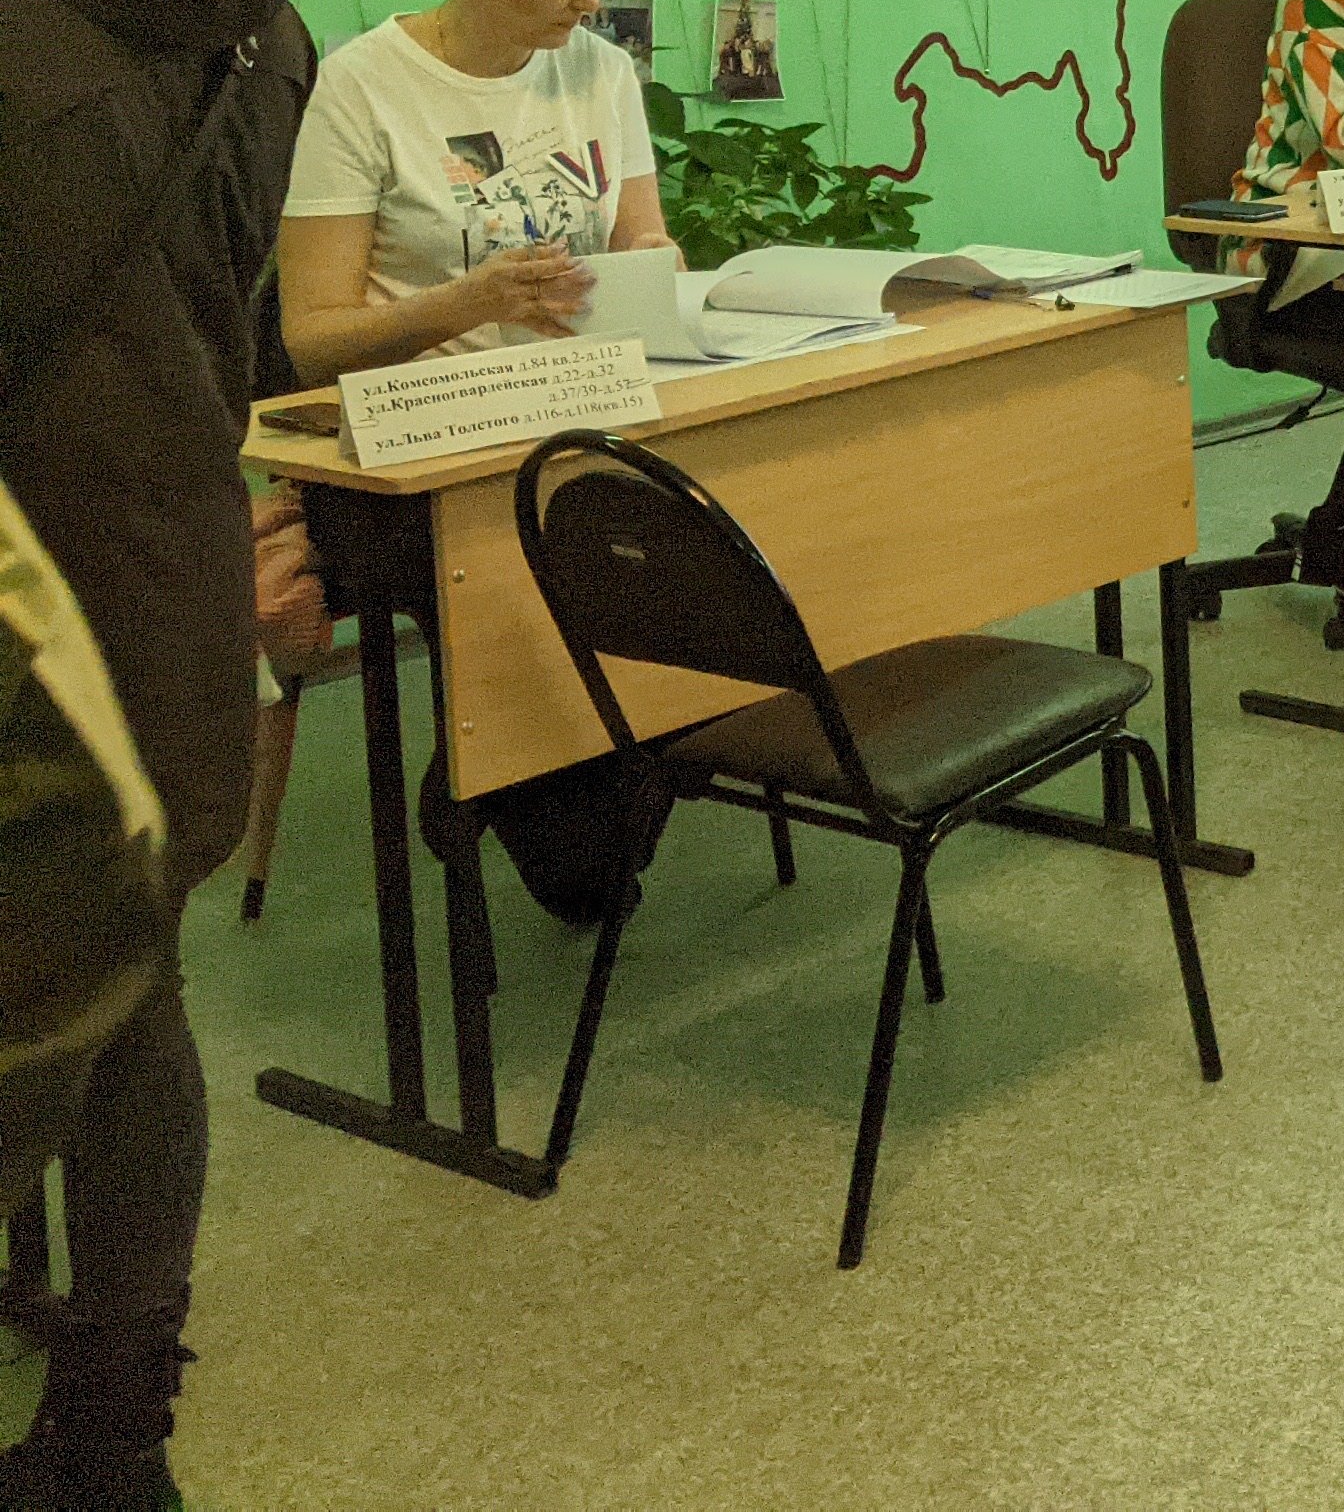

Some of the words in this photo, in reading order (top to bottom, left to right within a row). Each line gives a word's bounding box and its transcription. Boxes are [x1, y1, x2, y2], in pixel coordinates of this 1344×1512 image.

[362, 363, 514, 401] ул.Комсомольская
[366, 374, 548, 419] ул.Красногвардейская
[444, 414, 520, 438] Толстого
